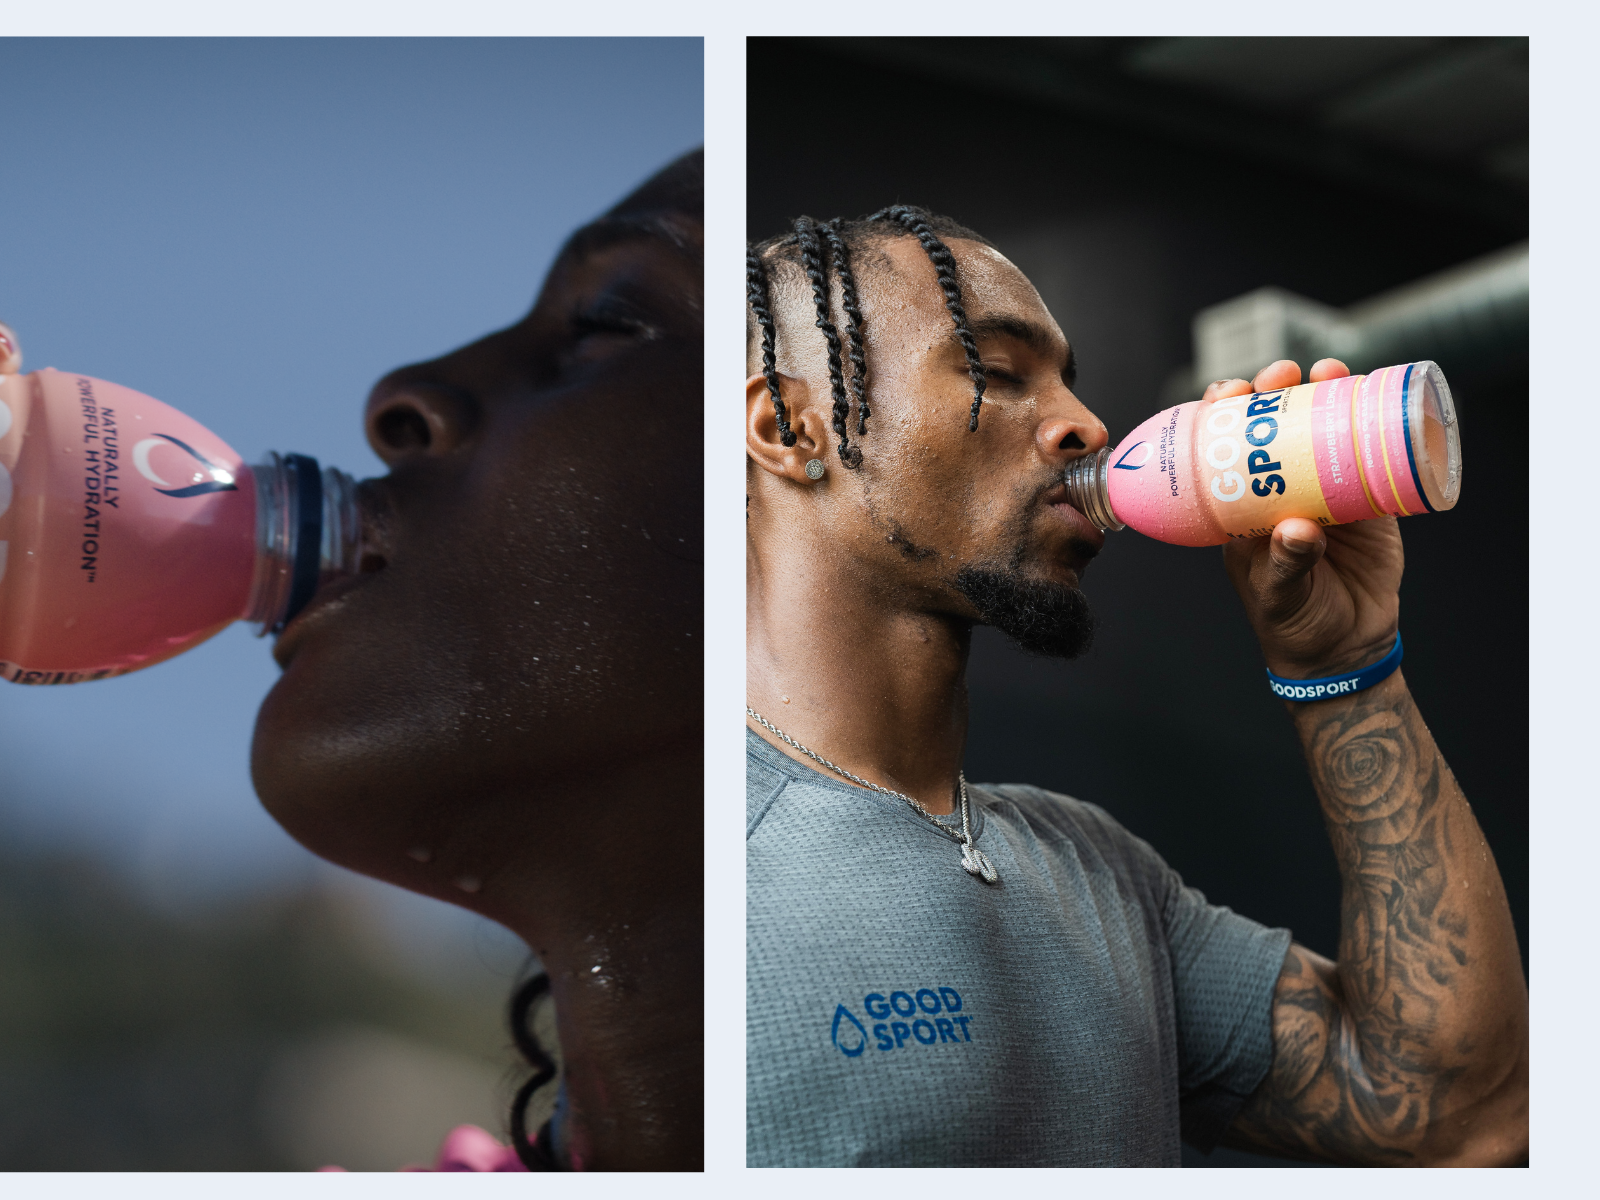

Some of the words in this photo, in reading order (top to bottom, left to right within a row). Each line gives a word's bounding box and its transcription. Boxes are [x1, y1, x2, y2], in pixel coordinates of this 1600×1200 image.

[77, 377, 98, 449] POWERFUL
[100, 406, 119, 509] NATURALLY
[1160, 426, 1168, 473] NATURALLY
[1168, 444, 1179, 497] POWERFUL
[1326, 411, 1343, 484] STRAWBERRY
[1364, 433, 1374, 468] 1600mg
[1269, 678, 1359, 698] GOODSPORT
[864, 986, 963, 1020] GOOD
[873, 1016, 973, 1051] SPORT
